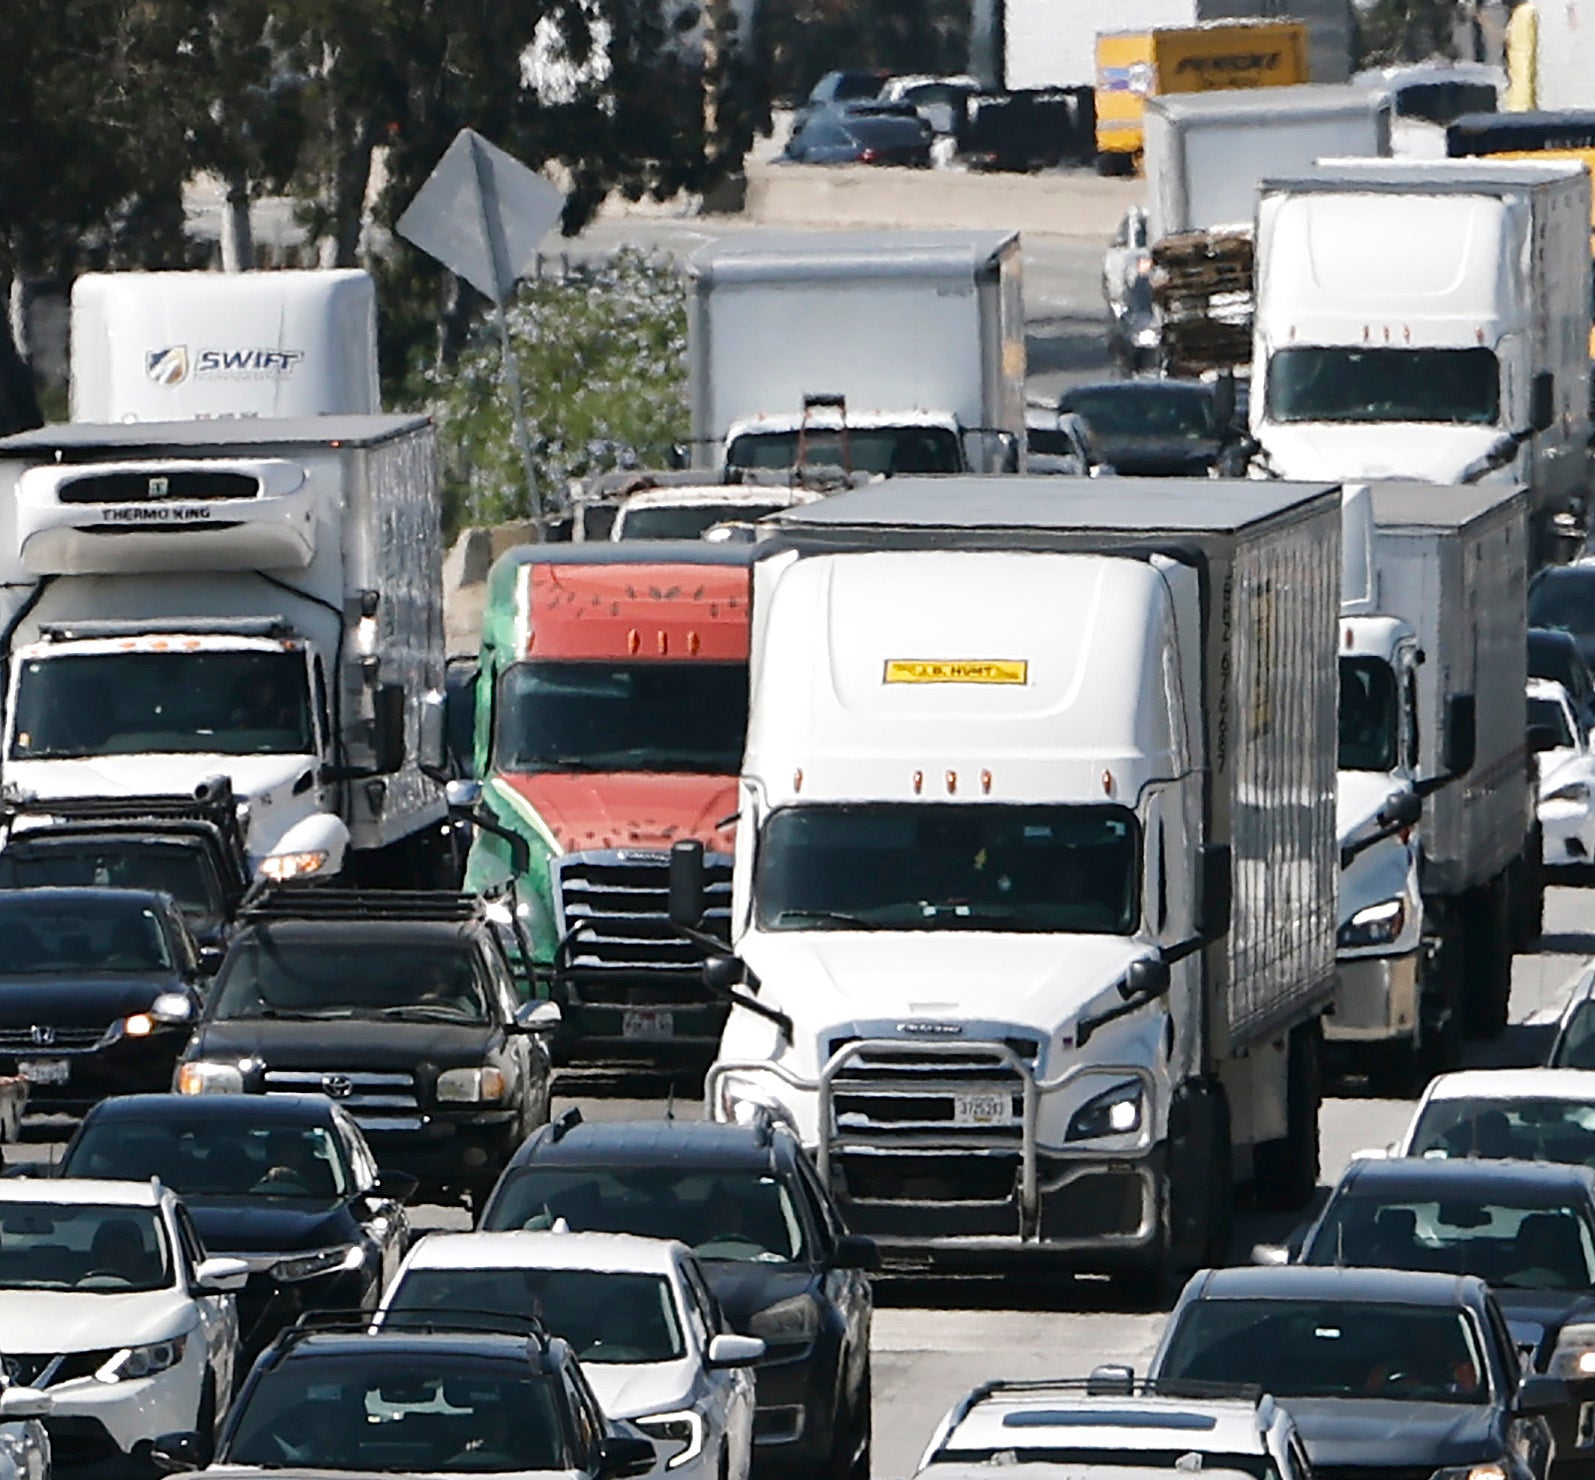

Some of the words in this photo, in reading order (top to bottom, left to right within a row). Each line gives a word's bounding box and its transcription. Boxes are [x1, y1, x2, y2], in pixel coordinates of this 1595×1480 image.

[200, 351, 298, 370] SWIFT
[102, 508, 168, 522] THERMO
[172, 507, 211, 521] KING
